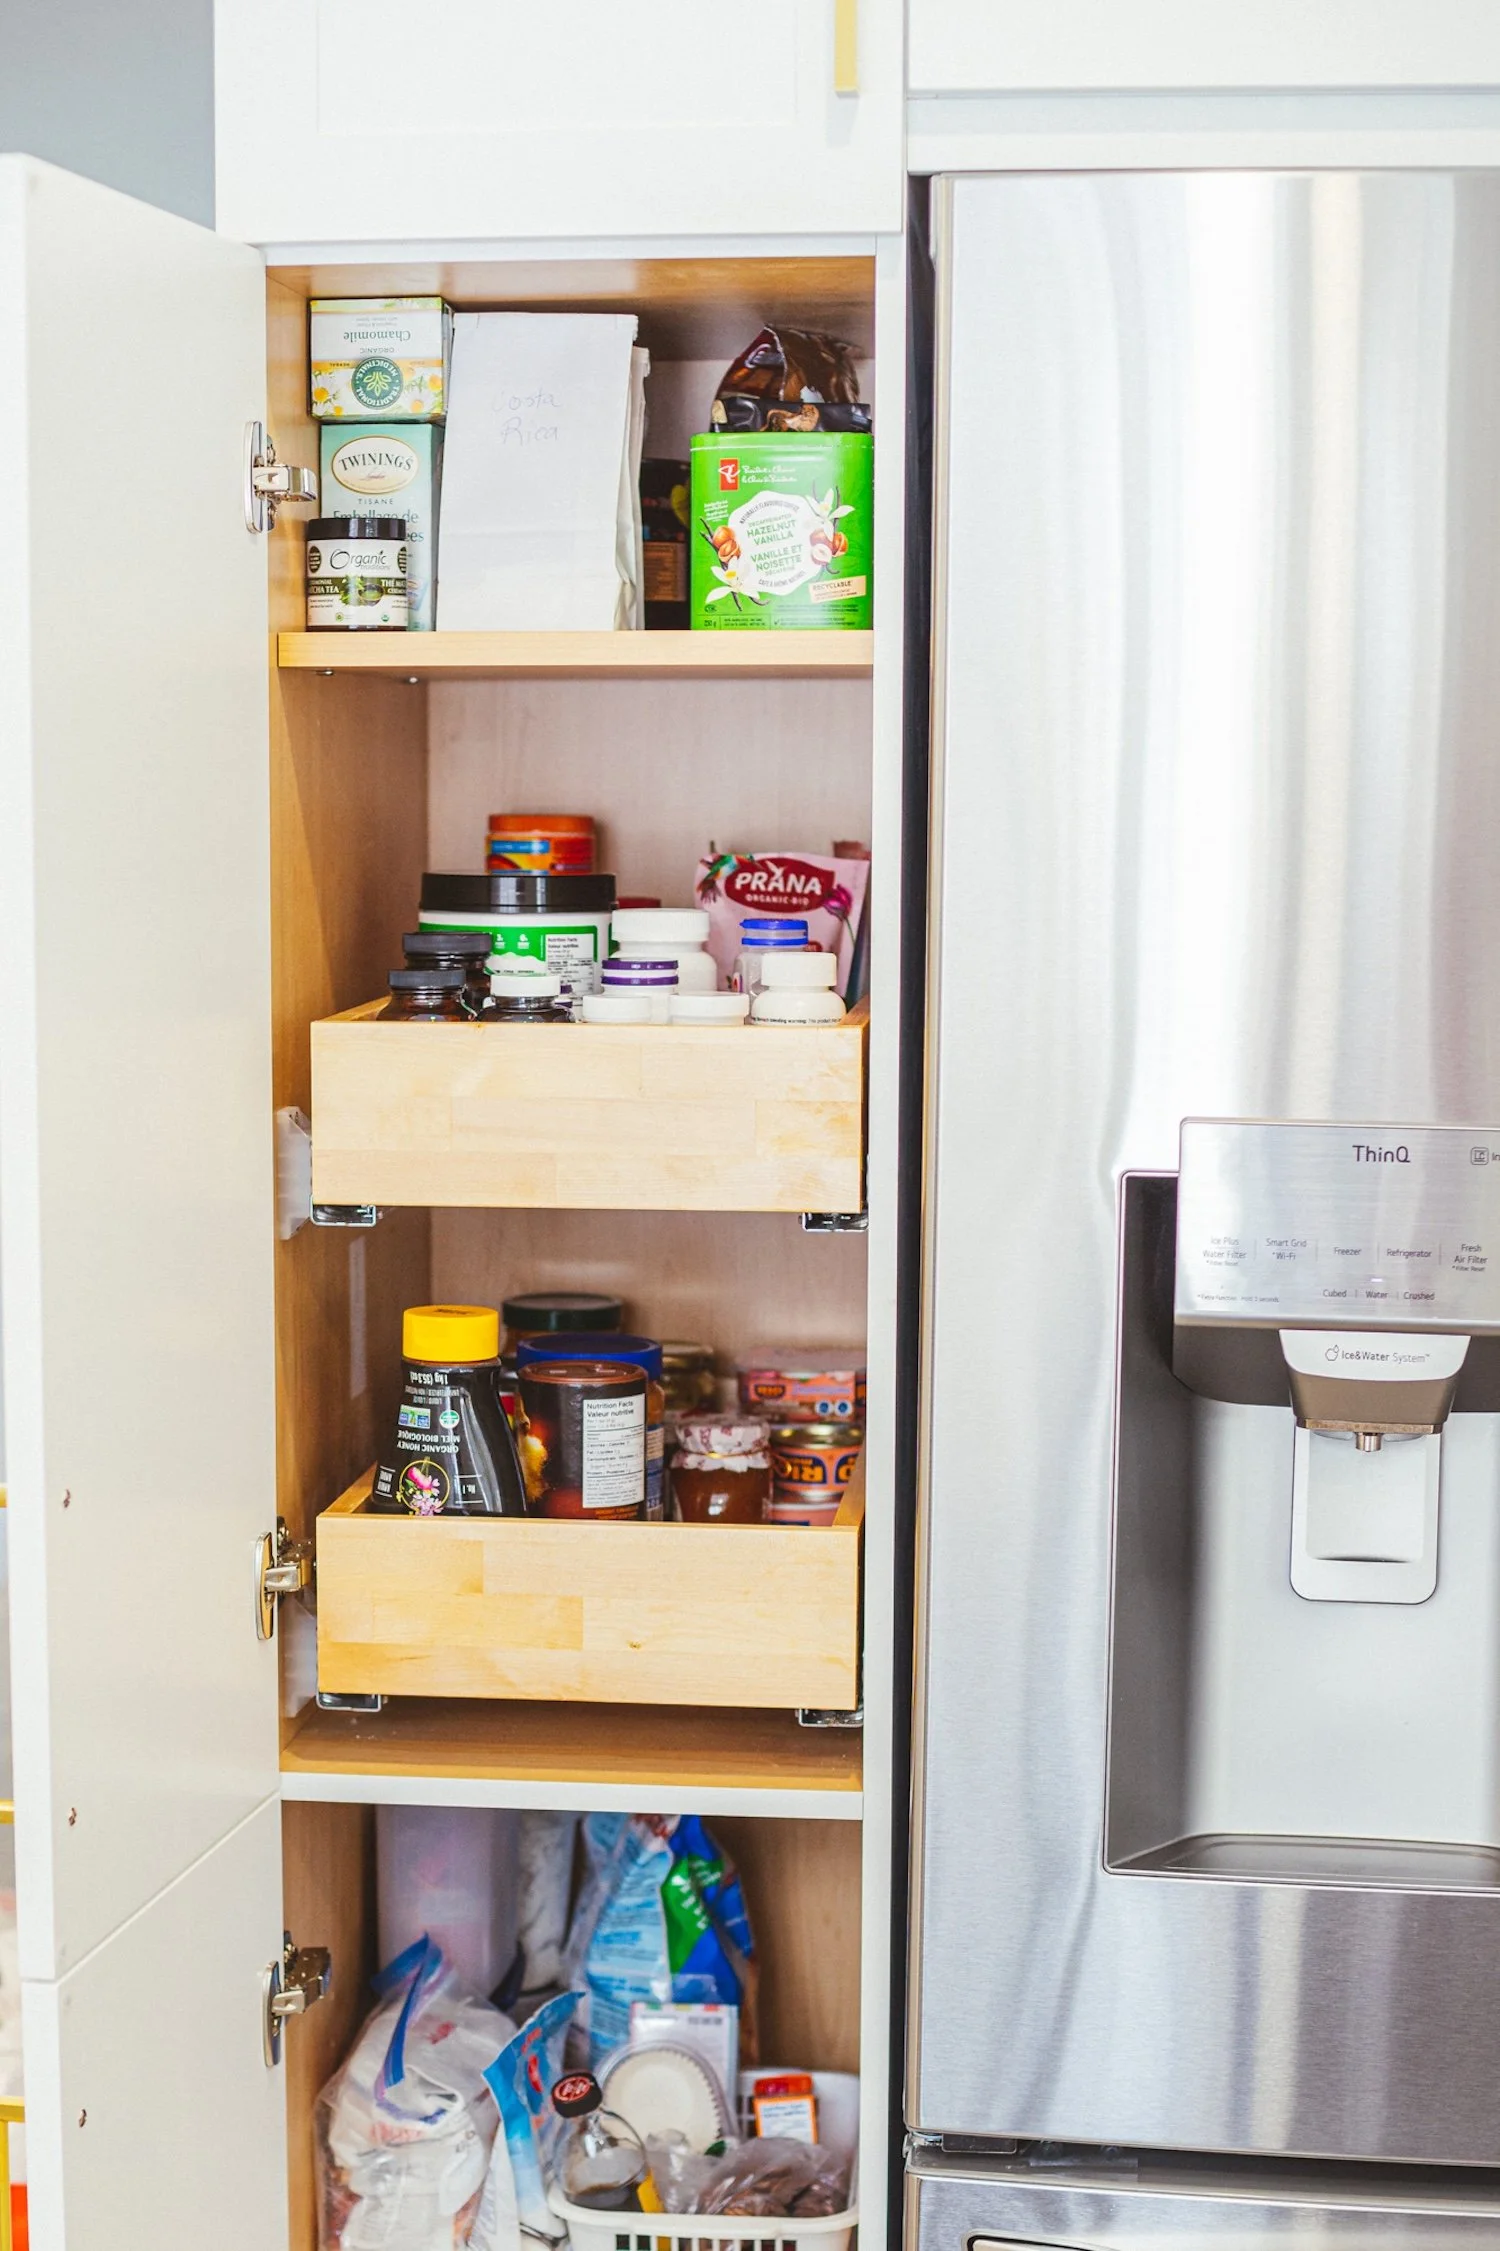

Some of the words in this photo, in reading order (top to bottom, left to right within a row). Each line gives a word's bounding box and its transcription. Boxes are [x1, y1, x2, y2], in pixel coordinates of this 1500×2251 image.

[343, 330, 411, 342] Chamomile
[355, 386, 400, 406] TRADITIONAL
[339, 453, 414, 472] TWININGS
[402, 509, 419, 523] de
[747, 520, 796, 537] HAZELNUT
[754, 531, 794, 545] VANILLA
[750, 547, 788, 562] VANILLE
[791, 544, 803, 554] ET
[330, 549, 387, 570] Organic
[756, 554, 801, 572] NOISETTE
[745, 894, 788, 904] ORGANIC
[1352, 1145, 1410, 1162] ThinQ
[1223, 1237, 1240, 1246] Plus
[1266, 1238, 1288, 1247] Smart
[1290, 1238, 1308, 1248] Grid
[1334, 1246, 1362, 1256] Freezer
[1386, 1248, 1432, 1259] Refrigerator
[1461, 1244, 1482, 1252] Fresh
[1203, 1250, 1224, 1258] Water
[1227, 1250, 1248, 1260] Filter
[1454, 1256, 1465, 1264] Air
[1468, 1256, 1488, 1264] Filter
[1323, 1289, 1347, 1298] Cubed
[1366, 1290, 1388, 1299] Water
[1404, 1291, 1435, 1300] Crushed
[1342, 1351, 1390, 1362] Ice&Water
[434, 1372, 444, 1385] kg
[587, 1401, 617, 1410] Nutrition
[587, 1410, 610, 1418] Valeur
[611, 1408, 634, 1416] nutritive
[398, 1430, 438, 1442] BIOLOGIQUE
[440, 1434, 460, 1444] MIEL
[397, 1440, 420, 1452] HONEY
[422, 1444, 459, 1453] ORGANIC
